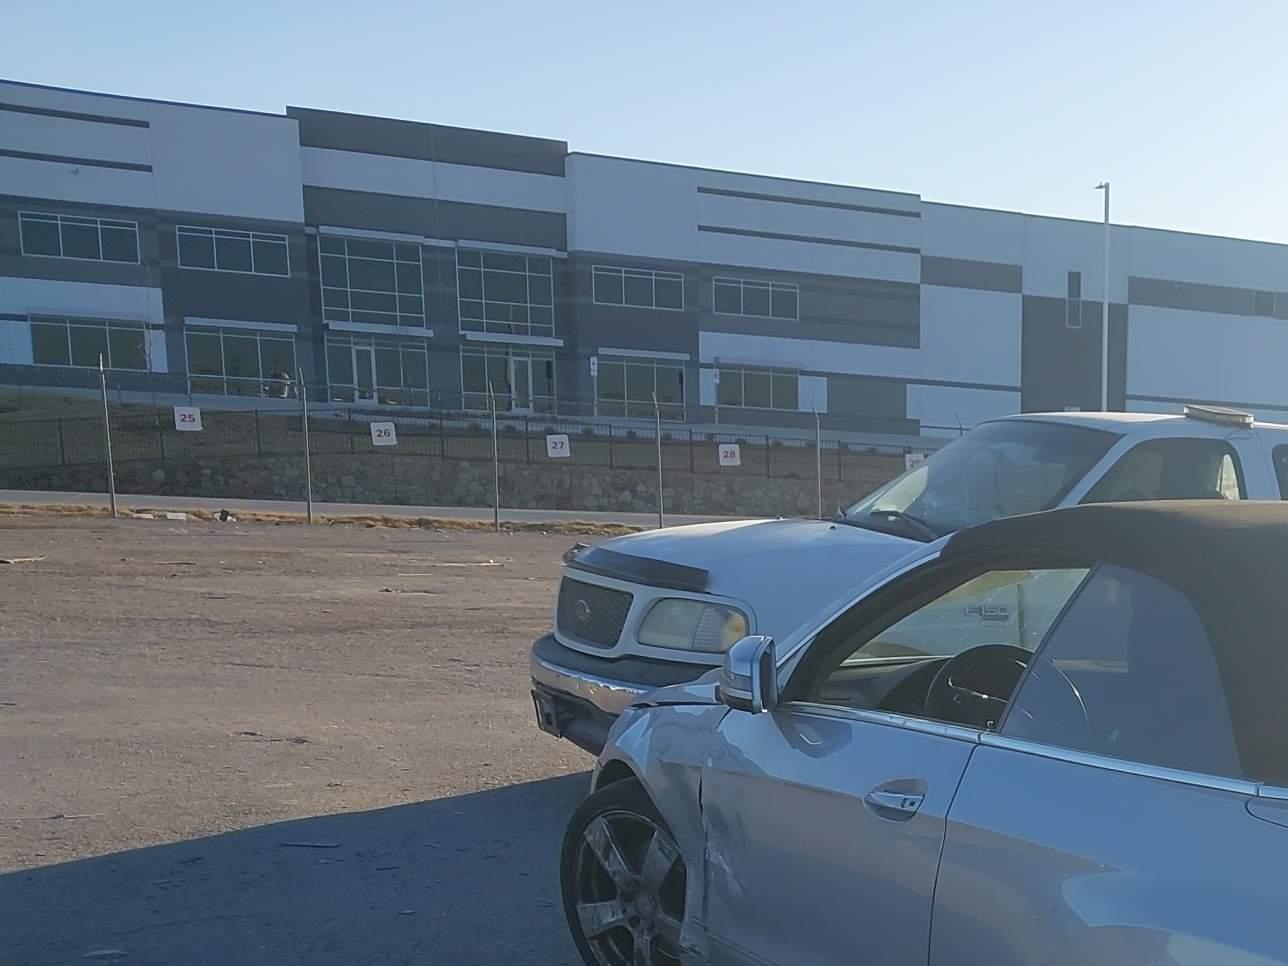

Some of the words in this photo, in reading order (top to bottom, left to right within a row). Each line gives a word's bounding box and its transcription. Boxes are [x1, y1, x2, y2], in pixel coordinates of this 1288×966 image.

[180, 414, 196, 423] 25
[376, 429, 391, 438] 26
[551, 441, 565, 450] 27
[723, 450, 736, 459] 28
